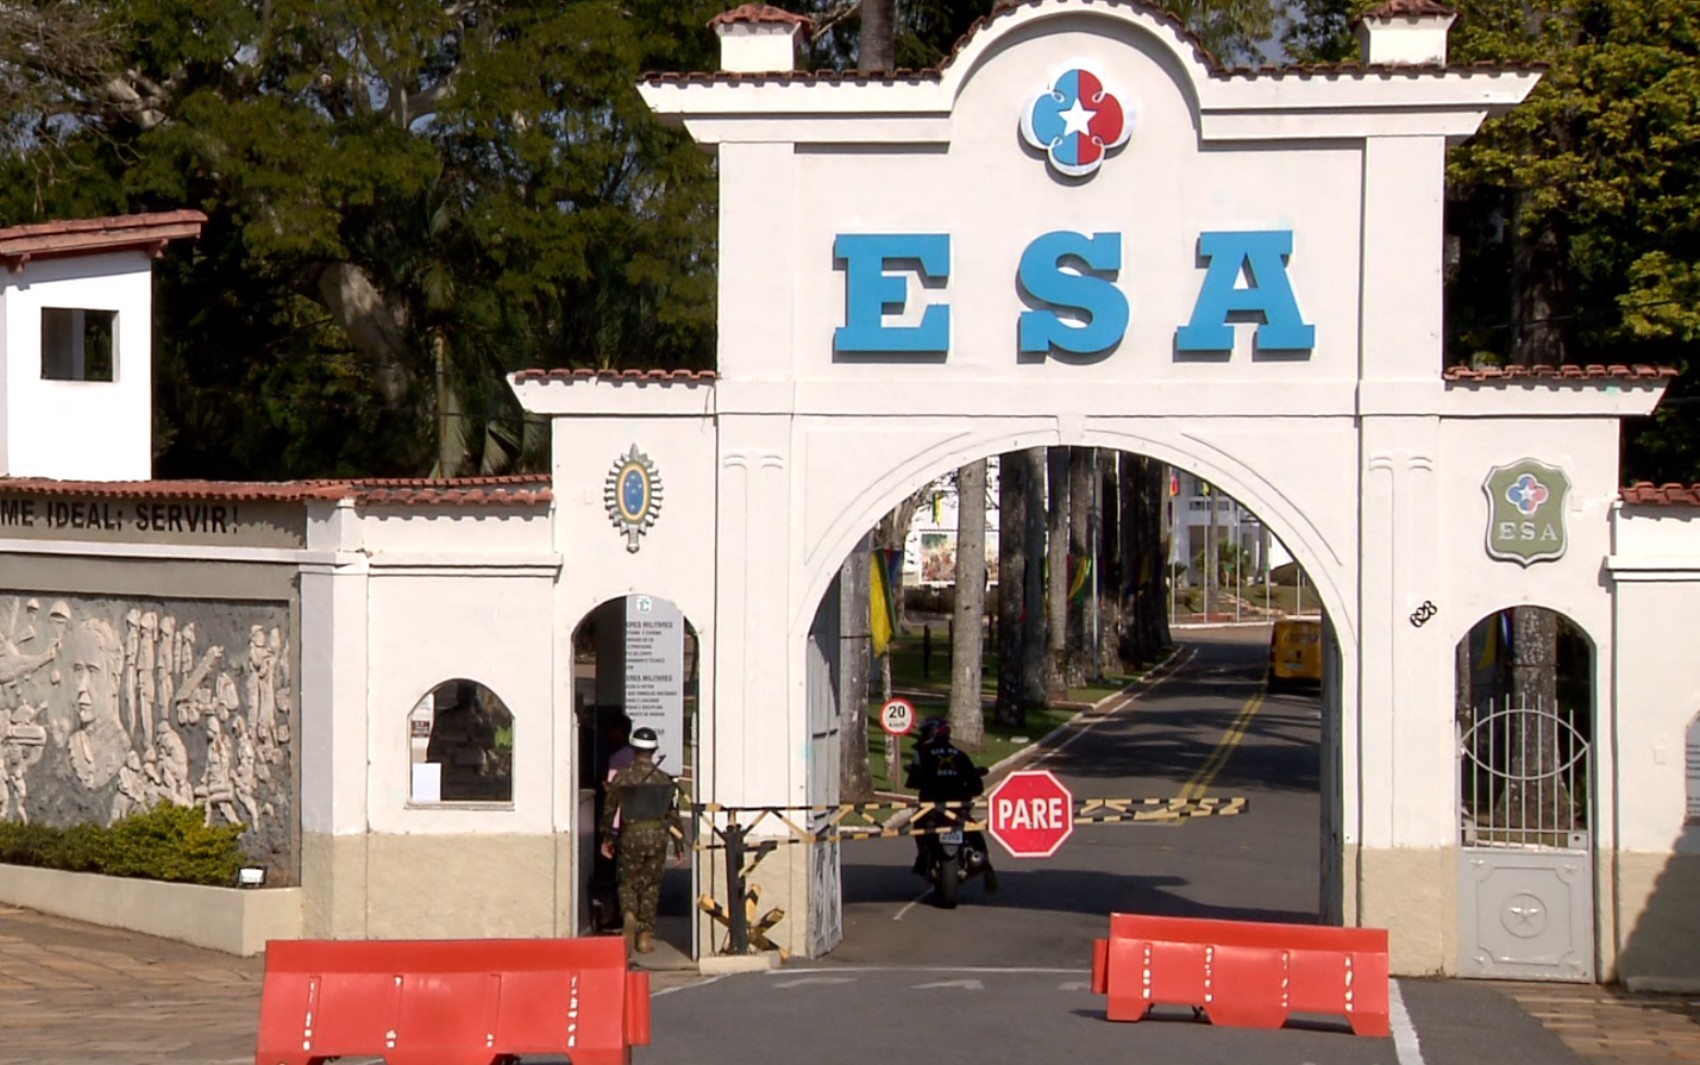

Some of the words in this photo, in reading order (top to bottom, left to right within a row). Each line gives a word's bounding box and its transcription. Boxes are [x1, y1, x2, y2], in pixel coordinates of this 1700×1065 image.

[834, 230, 1315, 360] ESA
[1, 499, 34, 526] ME
[136, 504, 238, 533] SERVIR!
[1498, 521, 1558, 541] ESA
[889, 705, 906, 719] 20
[998, 797, 1063, 830] PARE
